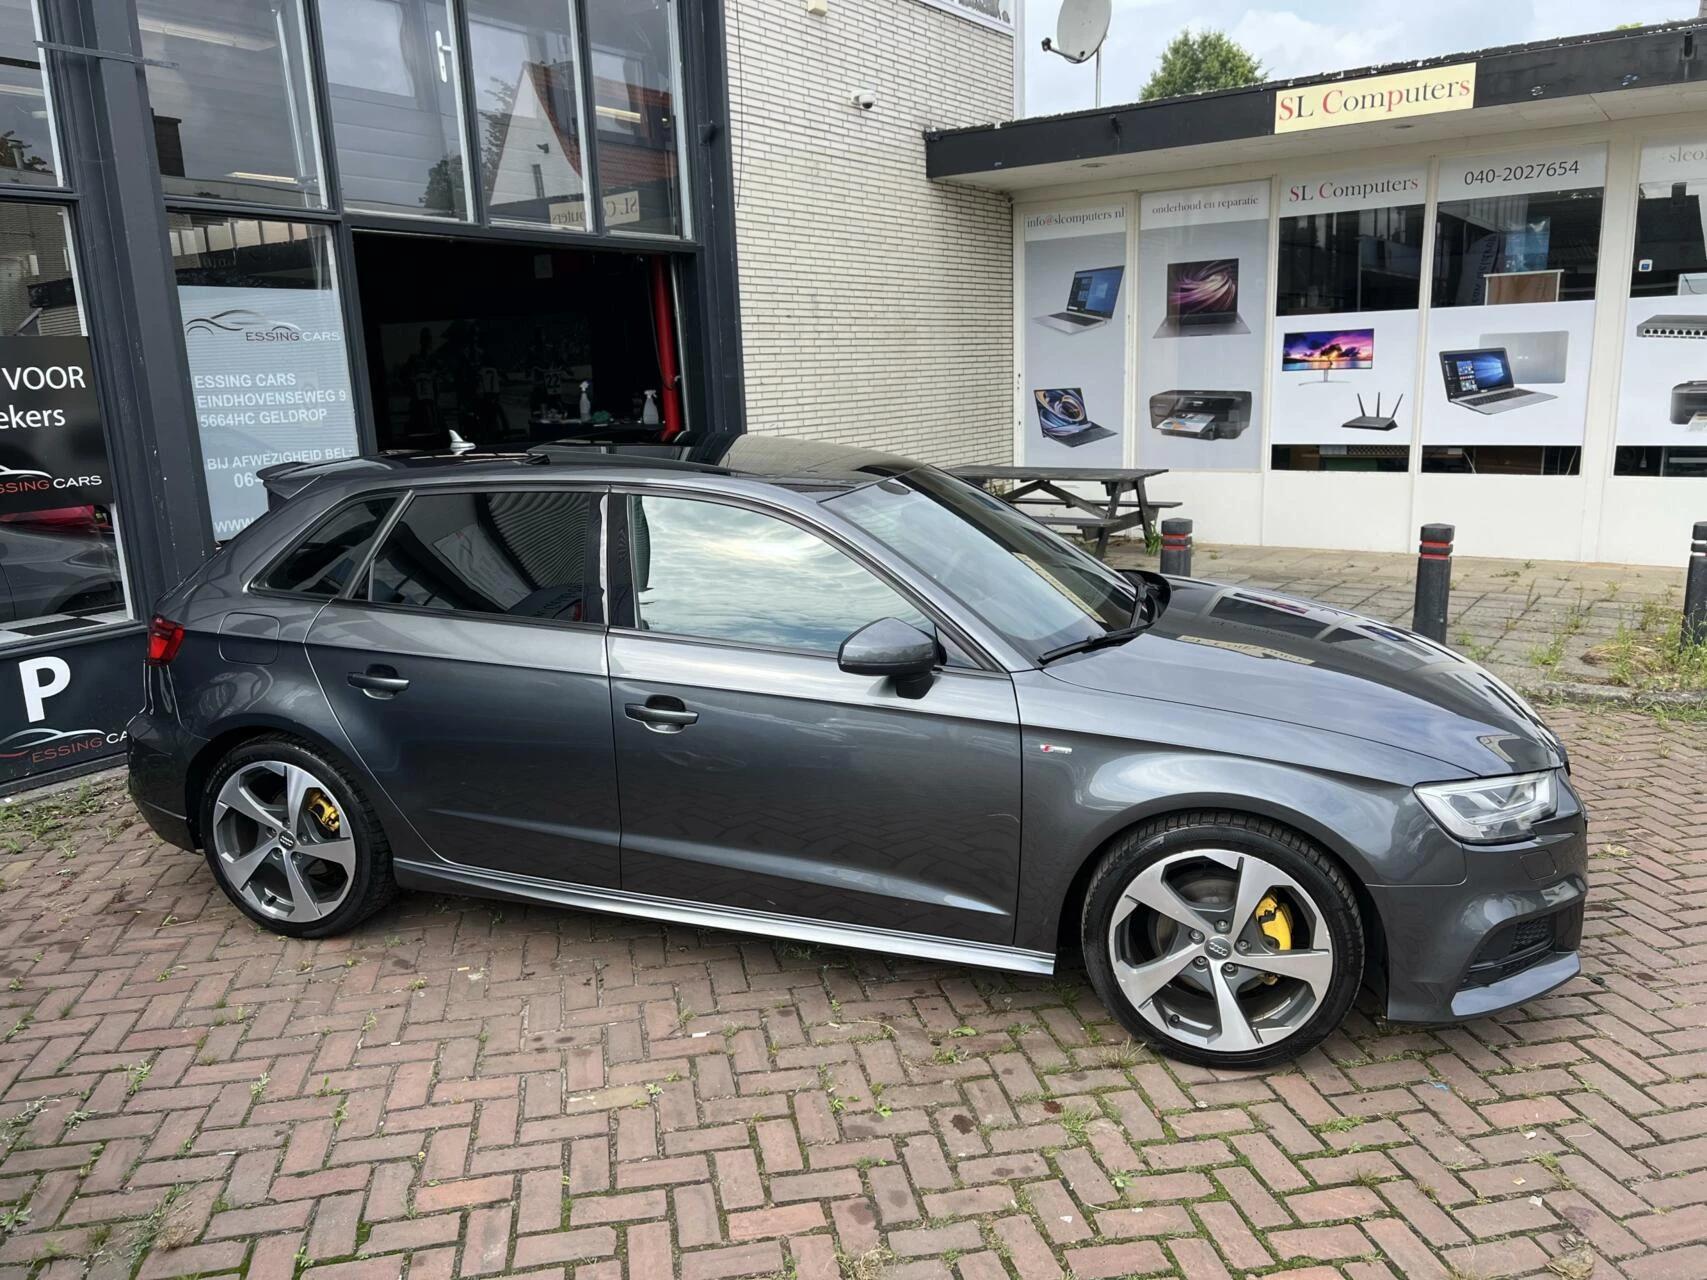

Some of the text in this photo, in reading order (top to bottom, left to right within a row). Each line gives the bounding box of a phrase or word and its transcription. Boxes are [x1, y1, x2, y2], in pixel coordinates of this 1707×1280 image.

[1279, 79, 1471, 121] SL Computers
[1464, 159, 1580, 185] 040-2027654
[1289, 176, 1419, 202] SL Computers
[1152, 195, 1259, 215] onderhoud en reparatie
[245, 331, 342, 342] ESSING CARS
[1, 366, 86, 391] VOOR
[194, 373, 296, 389] ESSING CARS
[196, 390, 346, 408] EINDHOVENSEWEG 9
[200, 408, 328, 428] 5664HC GELDROP
[207, 458, 228, 470] BIJ
[232, 449, 322, 468] AFWEZIGHEID
[53, 475, 102, 489] CARS
[19, 656, 71, 723] P
[32, 737, 103, 763] ESSING
